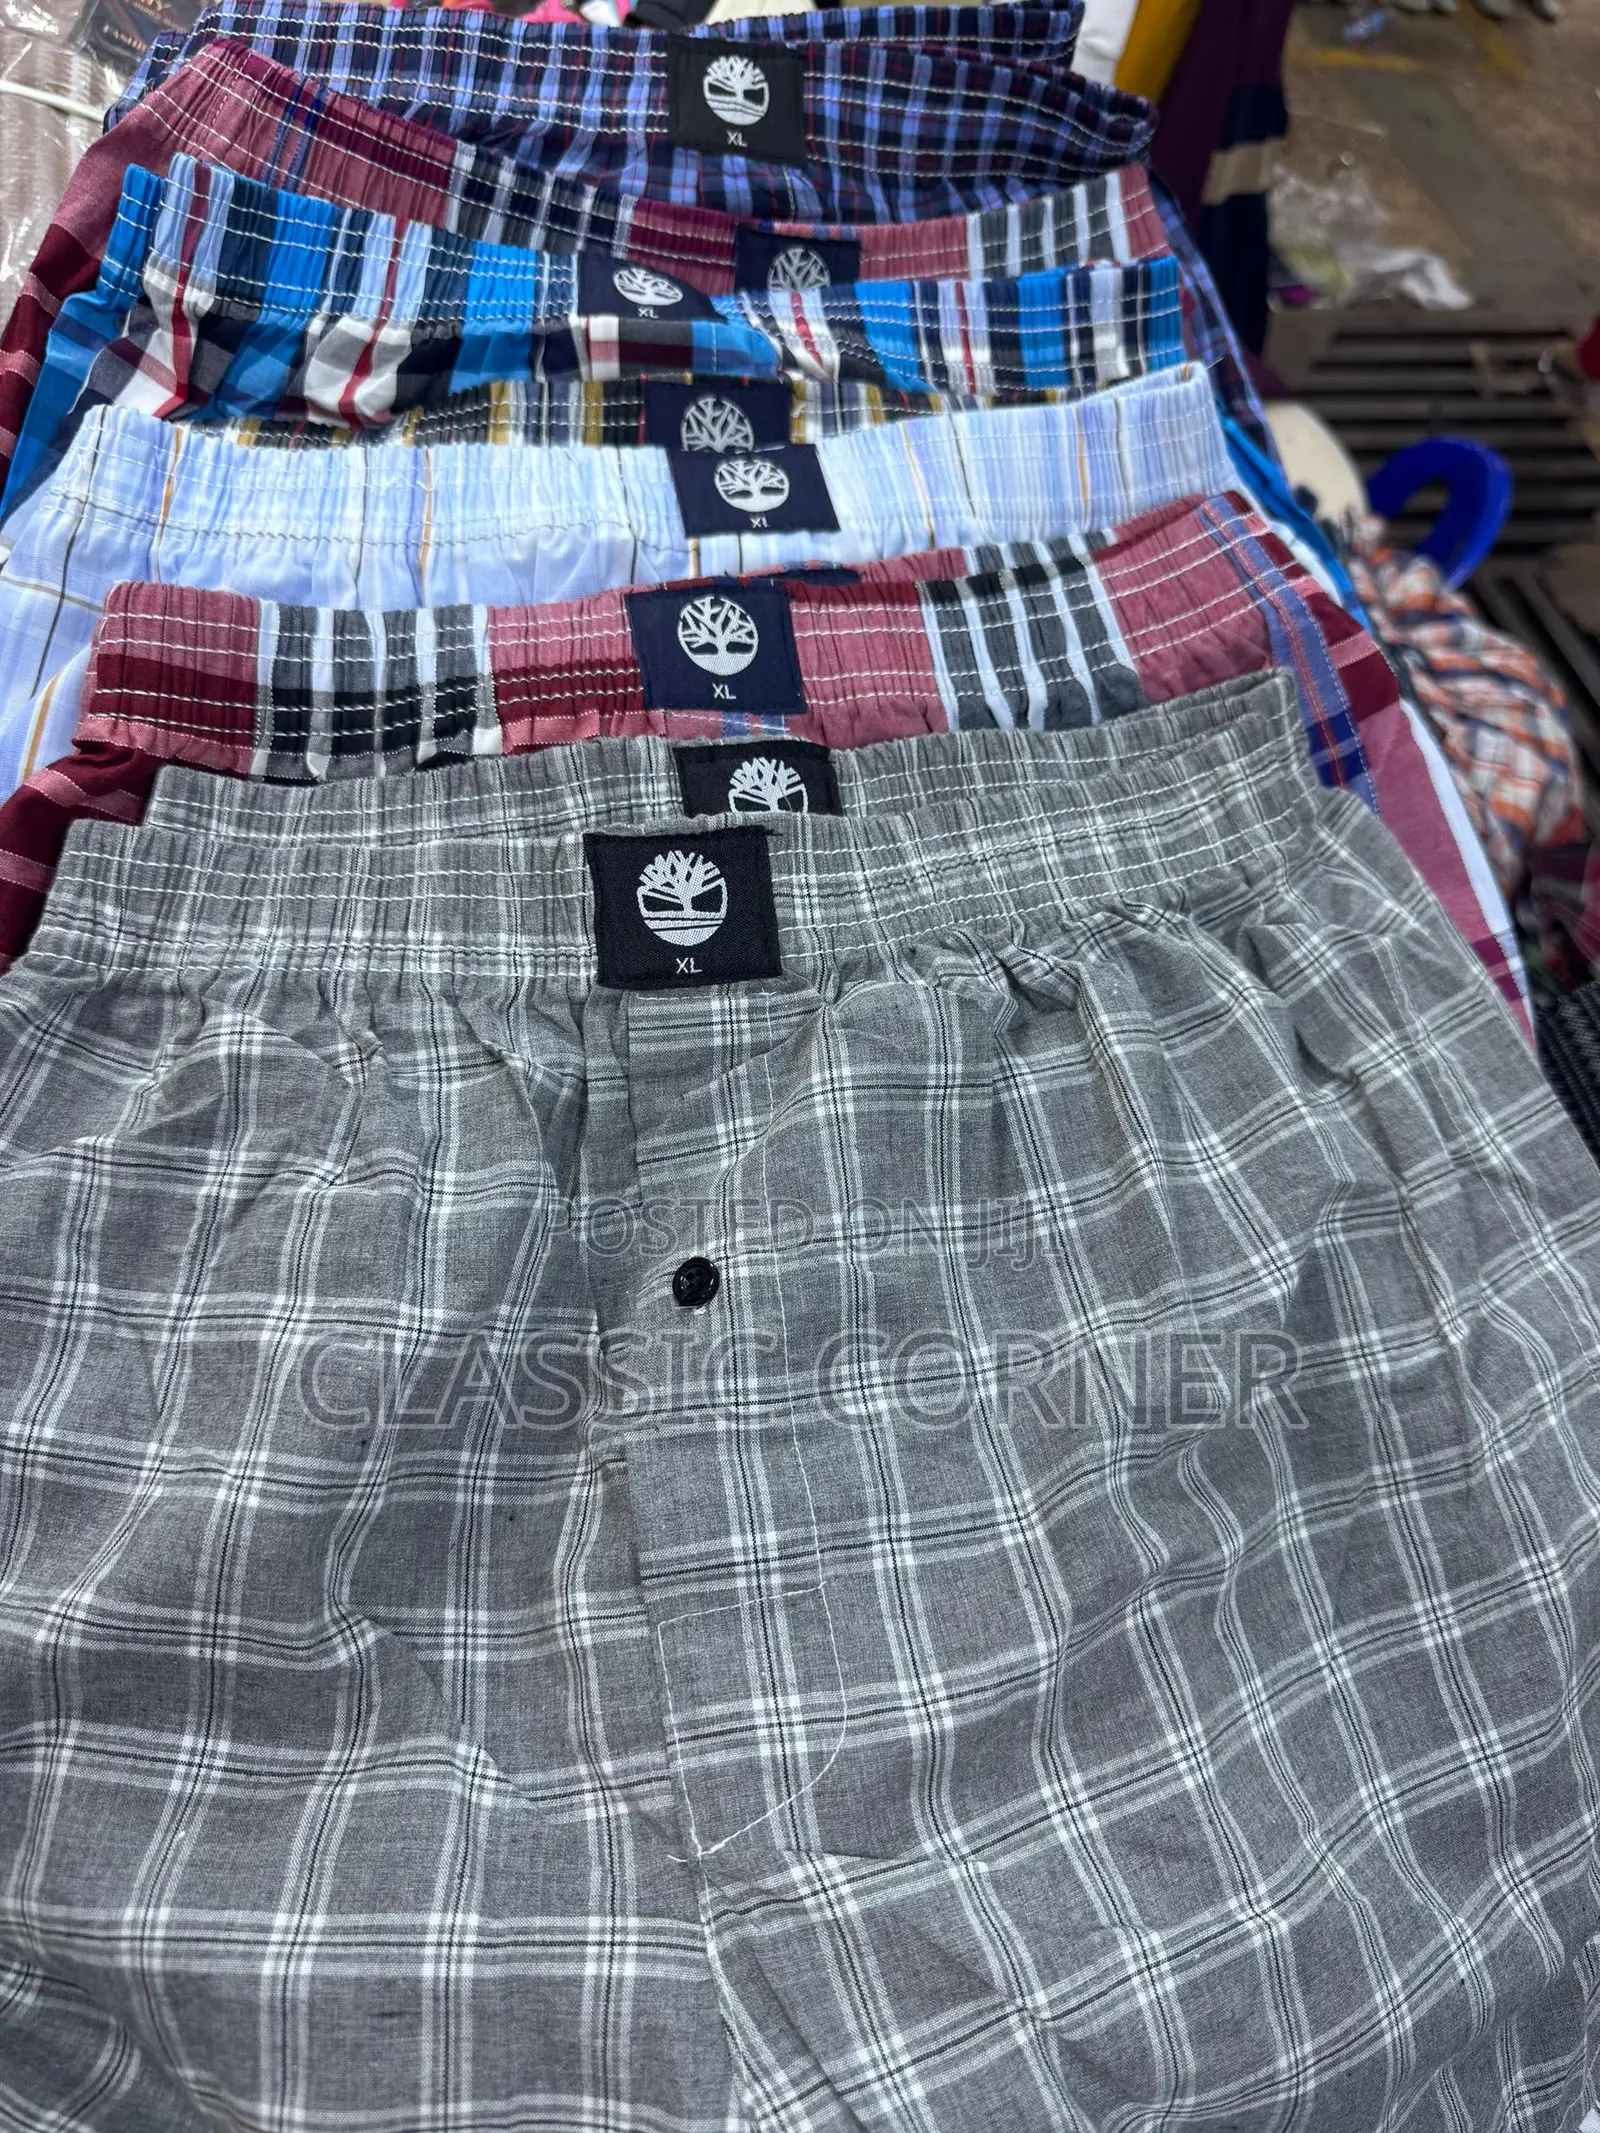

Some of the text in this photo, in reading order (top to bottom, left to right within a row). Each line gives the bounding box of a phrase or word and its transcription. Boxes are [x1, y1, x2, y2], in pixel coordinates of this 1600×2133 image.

[726, 129, 748, 148] XL
[638, 307, 659, 319] XL
[712, 682, 737, 700] XL
[675, 956, 703, 975] XL
